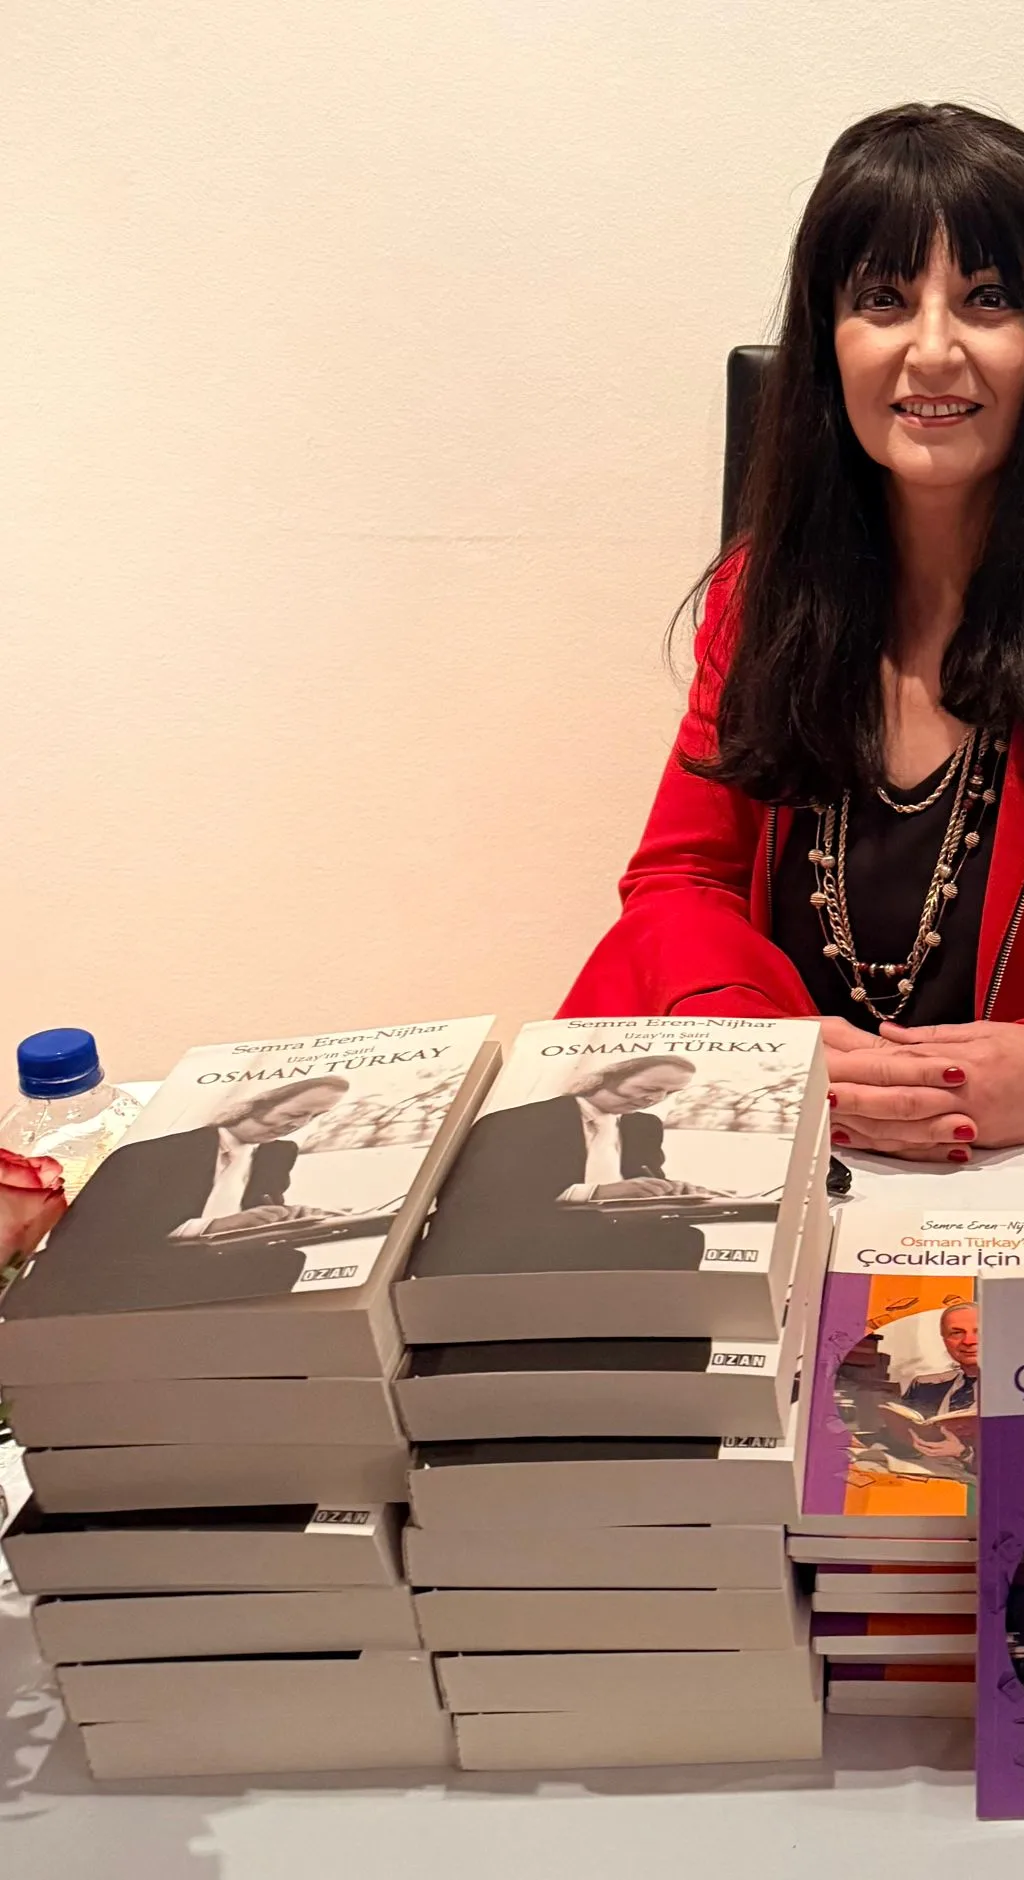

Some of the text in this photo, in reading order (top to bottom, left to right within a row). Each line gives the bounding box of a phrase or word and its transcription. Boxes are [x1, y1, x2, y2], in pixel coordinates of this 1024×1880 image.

[567, 1018, 777, 1030] Semra Eren-Nijhar
[231, 1024, 449, 1055] Semra Eren-Nijhar
[540, 1039, 786, 1057] OSMAN TÜRKAY
[196, 1045, 452, 1085] OSMAN TÜRKAY
[920, 1220, 963, 1231] Semra
[900, 1236, 962, 1248] Osman
[705, 1249, 758, 1262] OZAN
[856, 1249, 973, 1268] Çocuklar
[977, 1248, 1021, 1268] İçin
[301, 1265, 358, 1281] OZAN
[711, 1353, 766, 1367] OZAN
[723, 1436, 778, 1448] OZAN
[312, 1510, 371, 1525] OZAN
